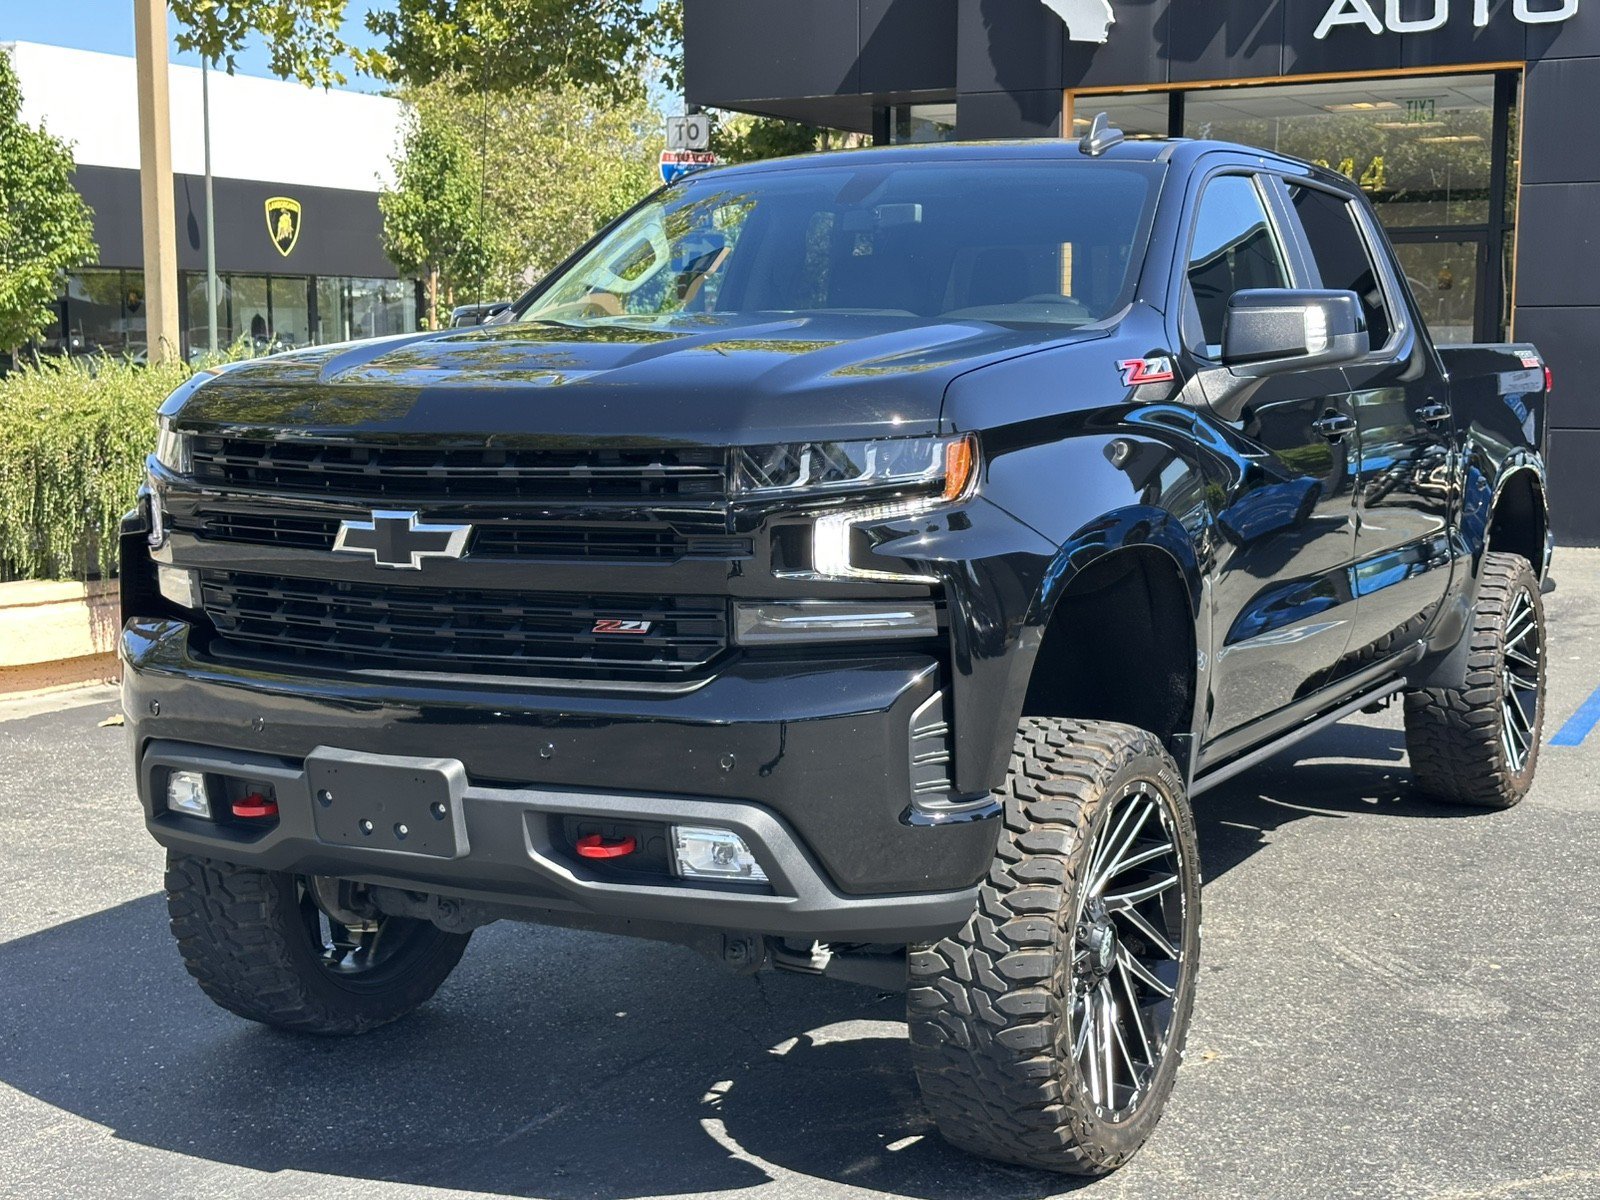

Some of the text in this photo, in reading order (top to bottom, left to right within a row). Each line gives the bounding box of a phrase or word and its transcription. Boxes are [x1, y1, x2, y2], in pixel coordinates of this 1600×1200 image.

[675, 123, 700, 141] TO
[1114, 356, 1174, 387] Z71
[592, 619, 651, 634] Z71
